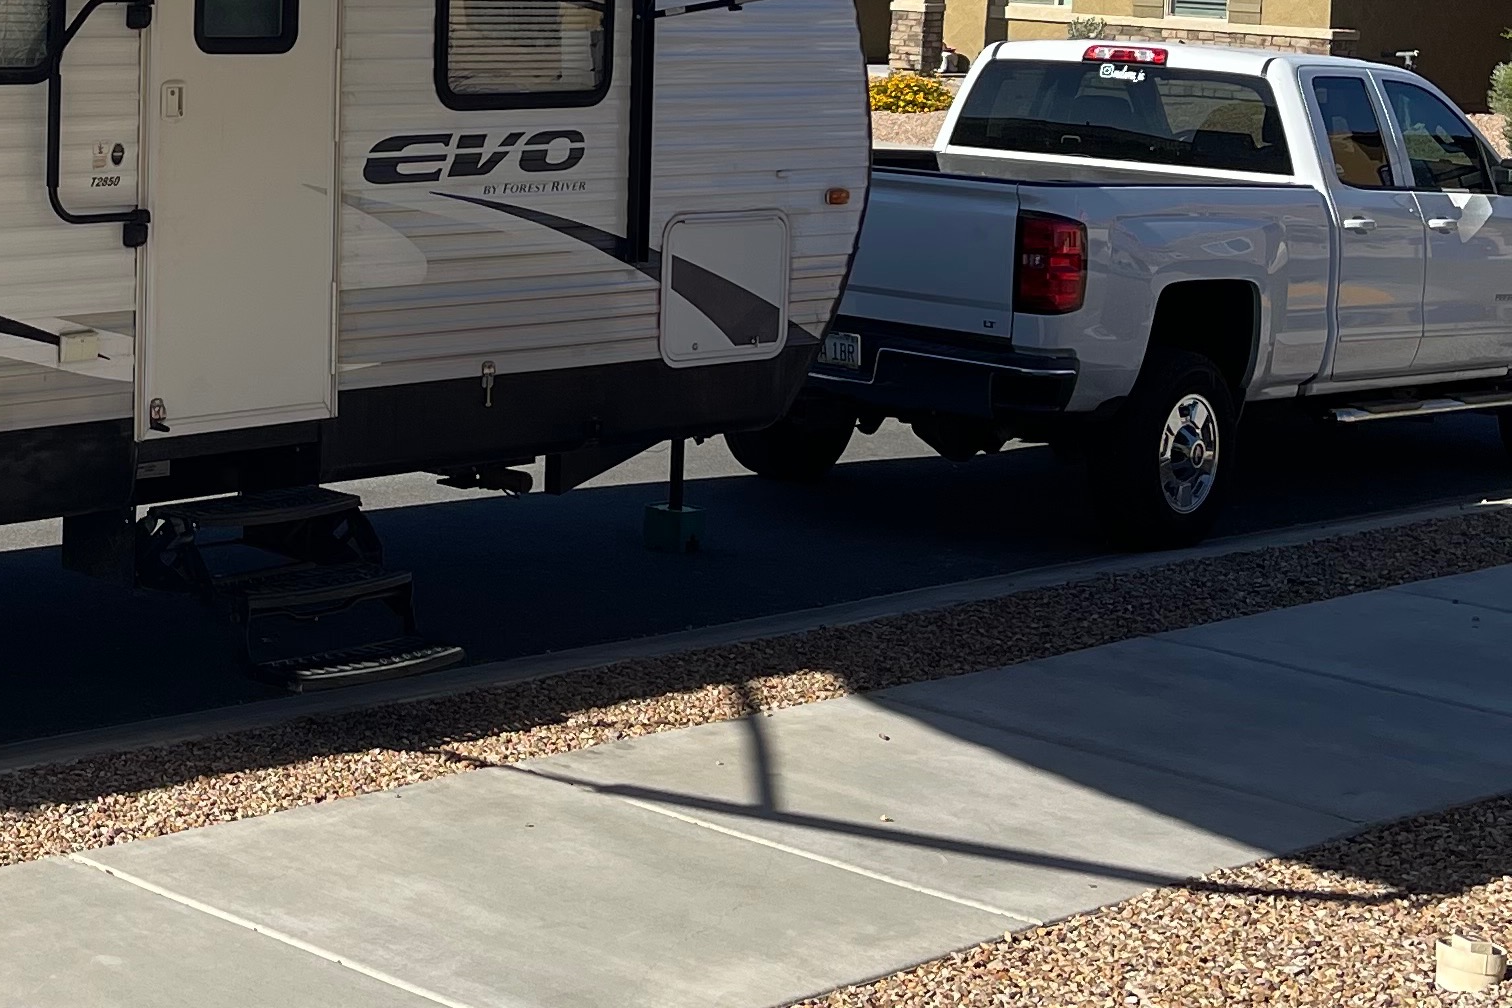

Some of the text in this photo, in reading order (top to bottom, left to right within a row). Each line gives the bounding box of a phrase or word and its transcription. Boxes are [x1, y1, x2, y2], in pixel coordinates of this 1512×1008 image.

[363, 129, 585, 184] EVO
[90, 176, 121, 188] T2850
[483, 180, 586, 195] BY FOREST RIVER
[984, 320, 996, 328] LT
[832, 341, 855, 362] 1BR
